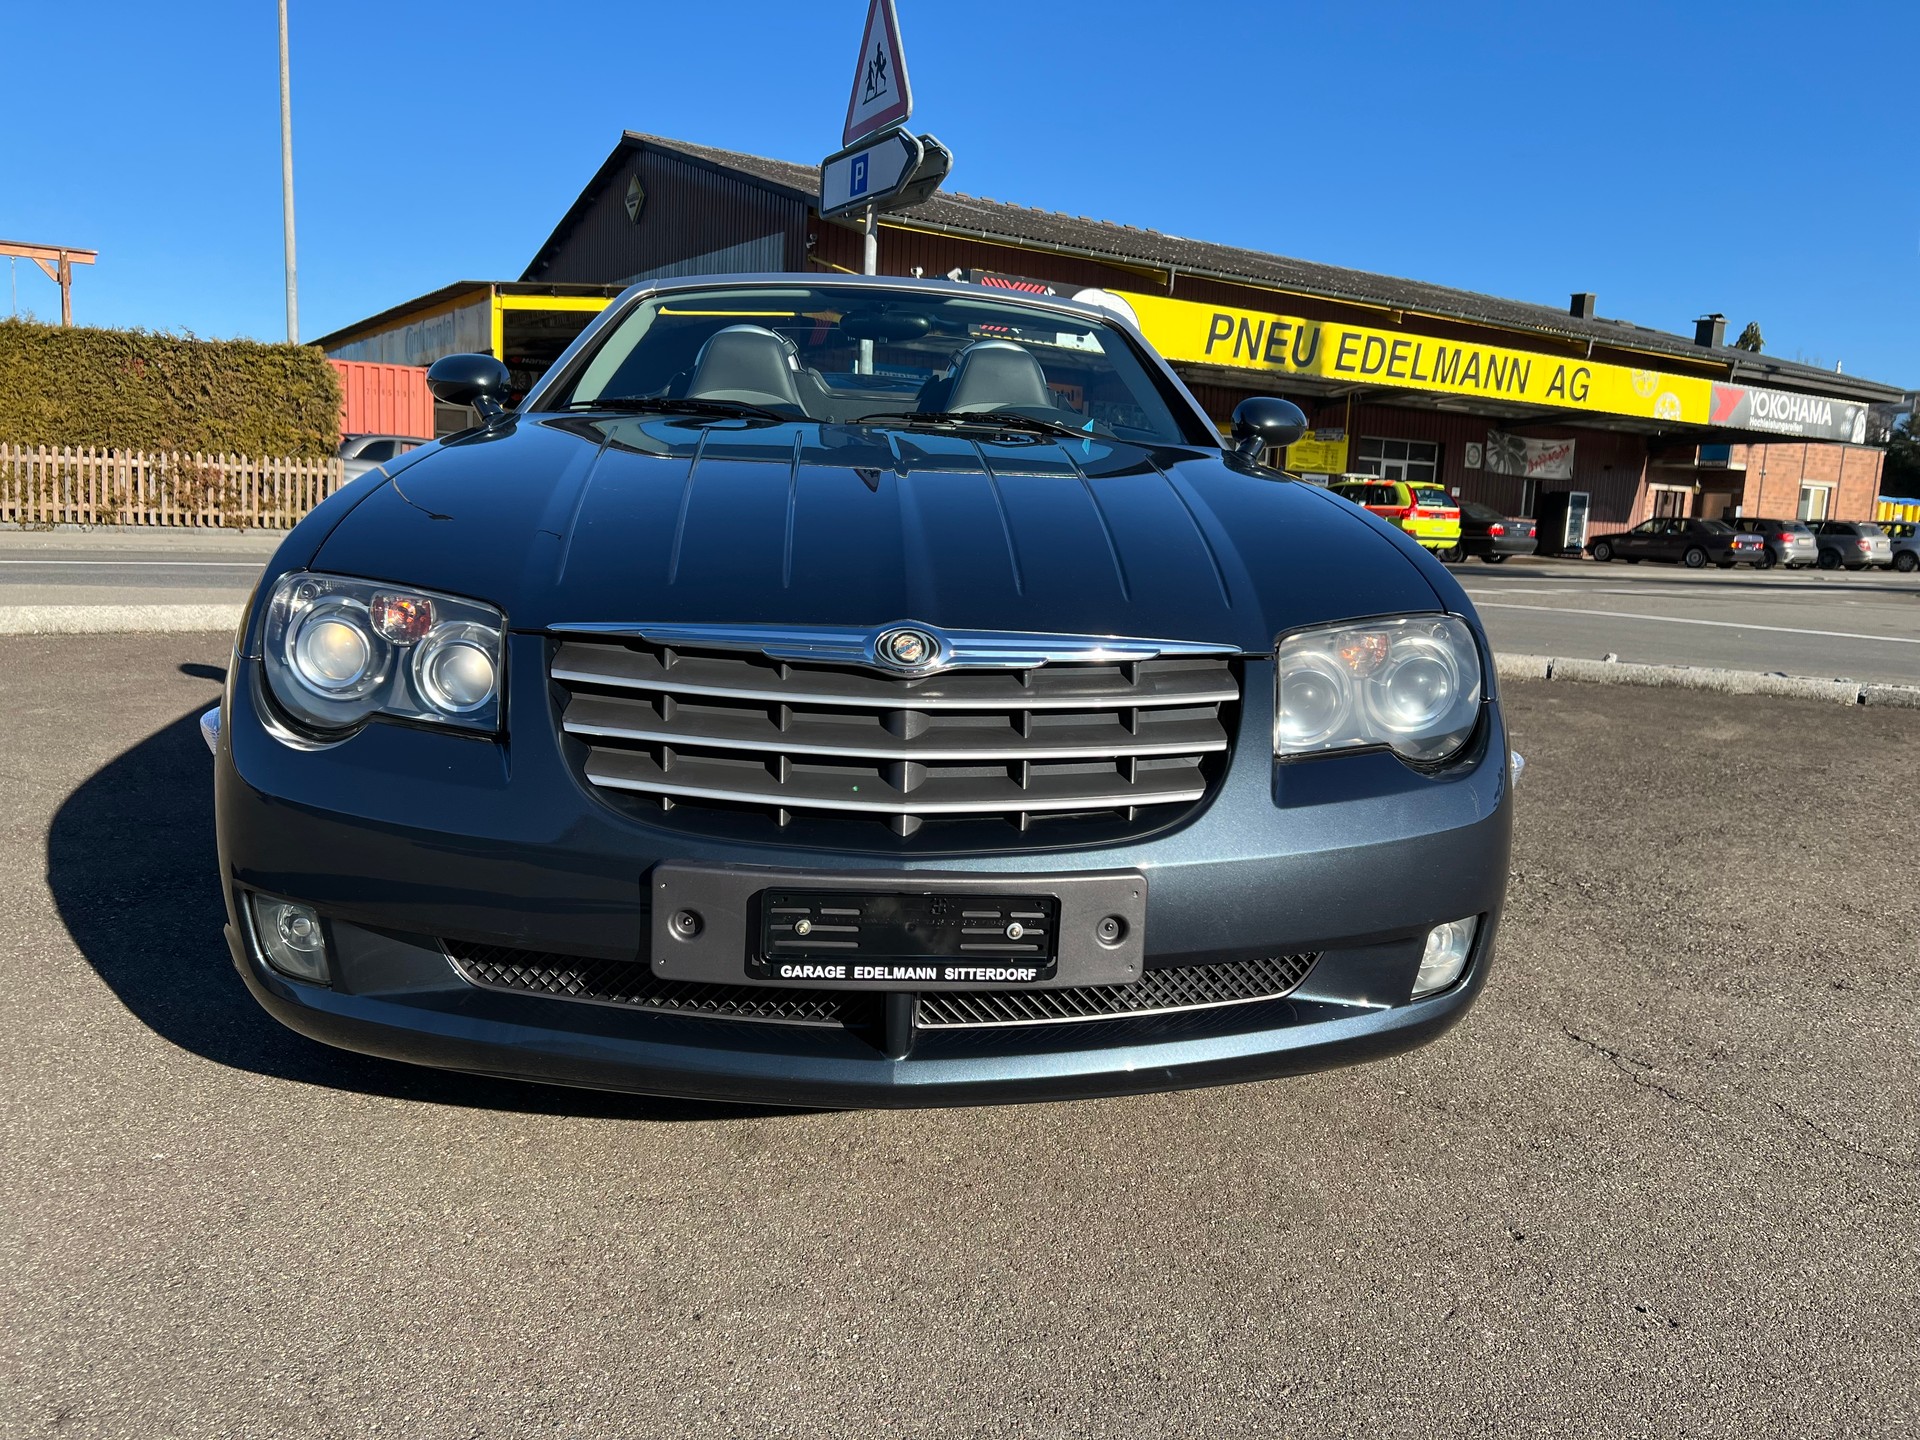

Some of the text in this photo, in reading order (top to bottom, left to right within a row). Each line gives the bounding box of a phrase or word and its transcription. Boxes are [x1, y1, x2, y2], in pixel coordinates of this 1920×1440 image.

[855, 162, 864, 191] P
[1204, 313, 1592, 403] PNEU EDELMANN AG
[1749, 390, 1832, 426] YOKOHAMA
[780, 965, 1037, 981] GARAGE EDELMANN SITTERDORF
